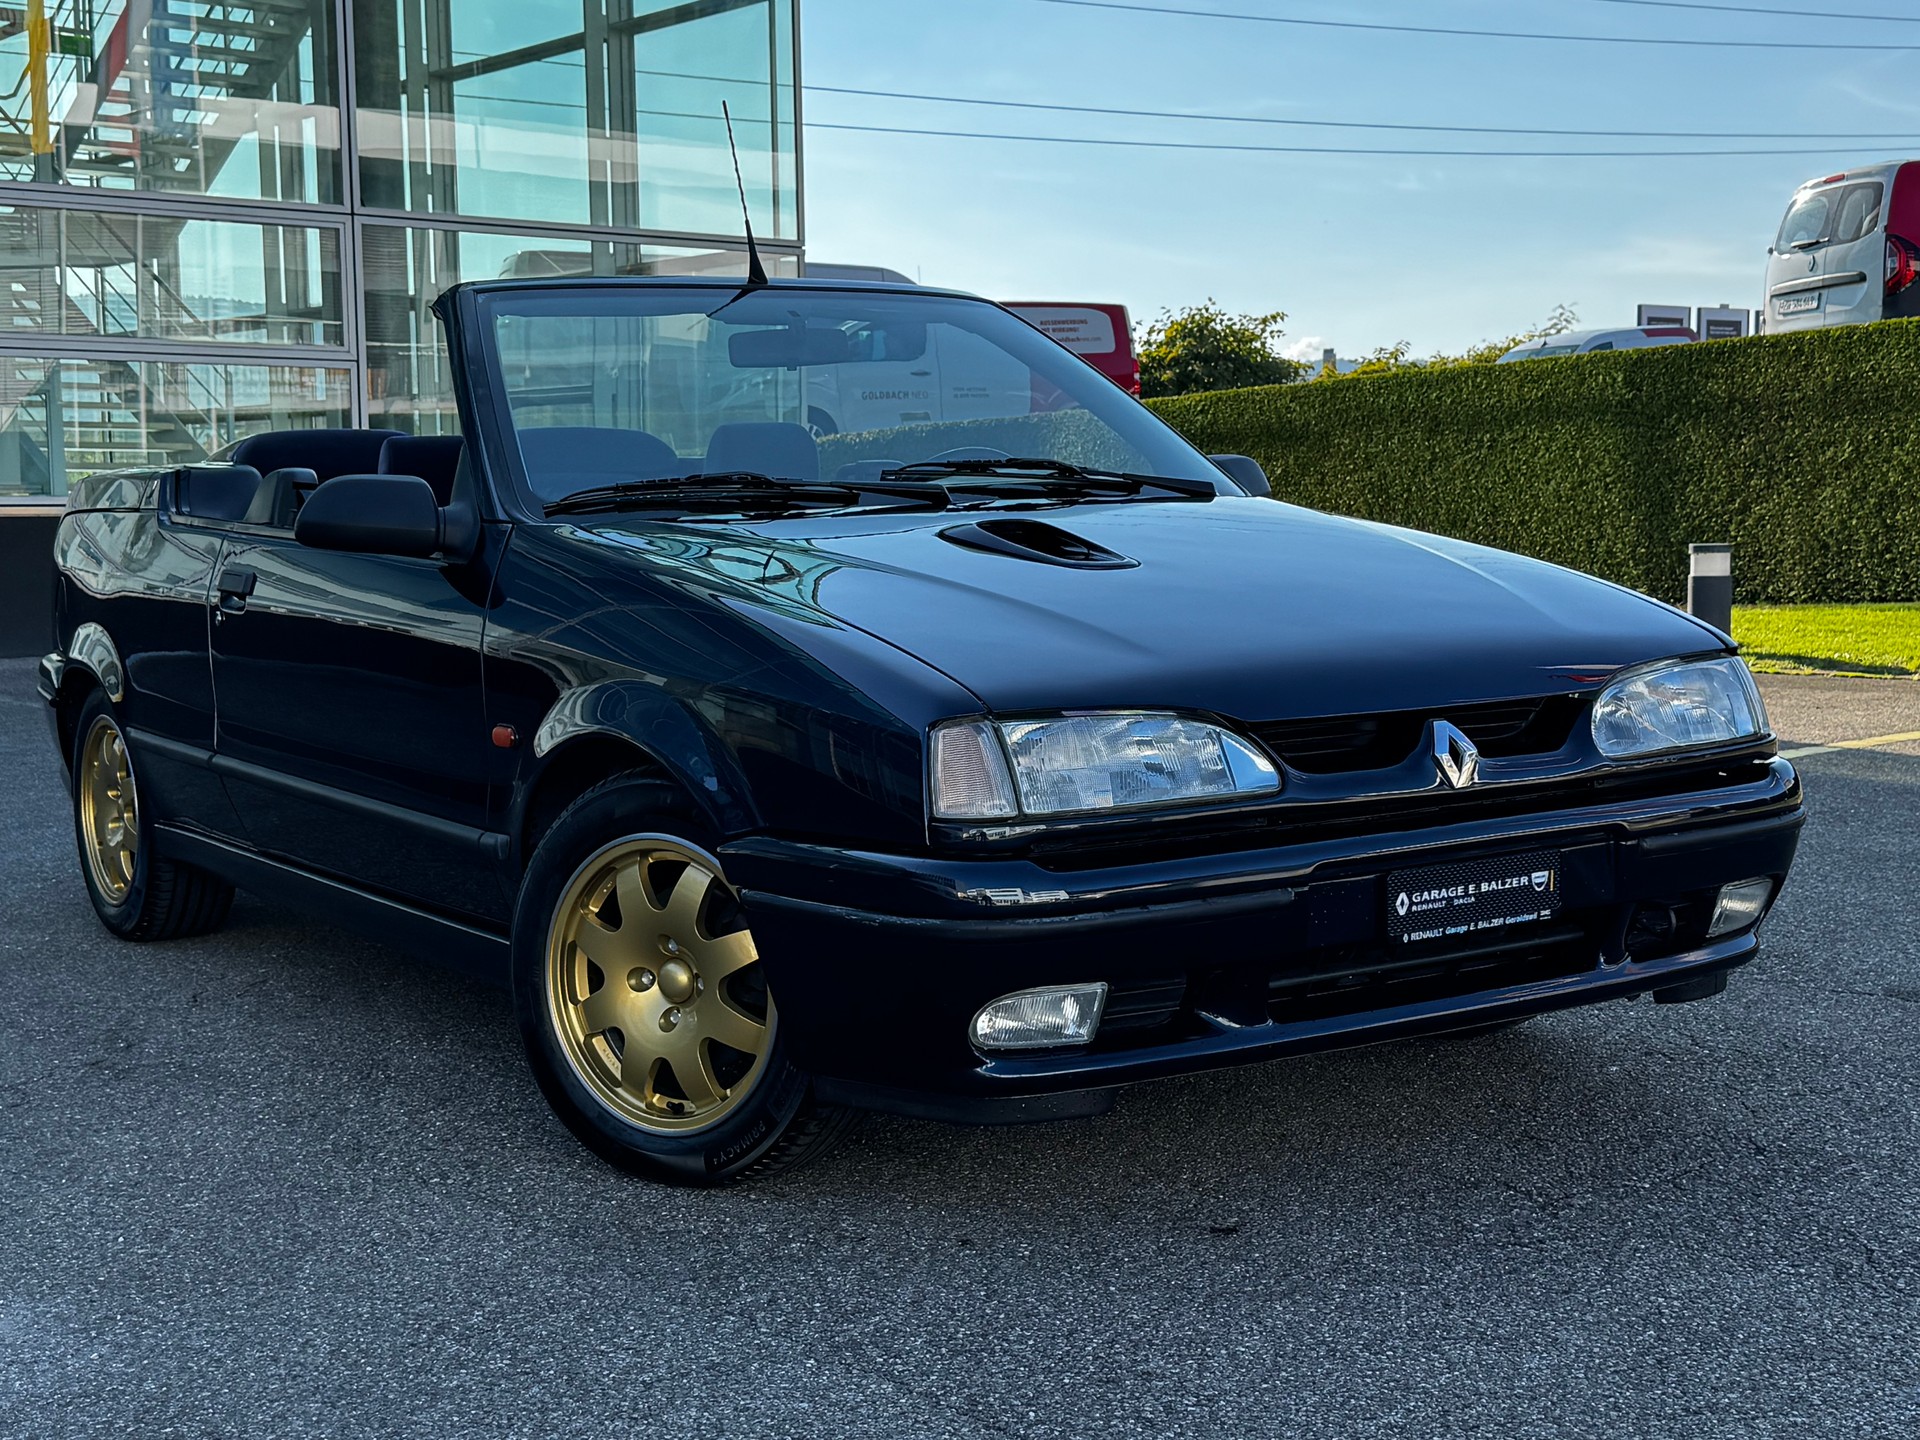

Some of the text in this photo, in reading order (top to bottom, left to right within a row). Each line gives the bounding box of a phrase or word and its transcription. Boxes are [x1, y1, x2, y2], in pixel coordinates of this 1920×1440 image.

[861, 390, 929, 401] GOLDBACH NEO
[1412, 885, 1465, 903] GARAGE
[1481, 875, 1529, 892] BALZER
[1411, 896, 1475, 912] RENAULT DACIA
[1410, 928, 1443, 942] RENAULT
[1445, 924, 1469, 936] Garage
[1477, 918, 1504, 930] BALZER
[720, 1120, 766, 1163] PRIMACY
